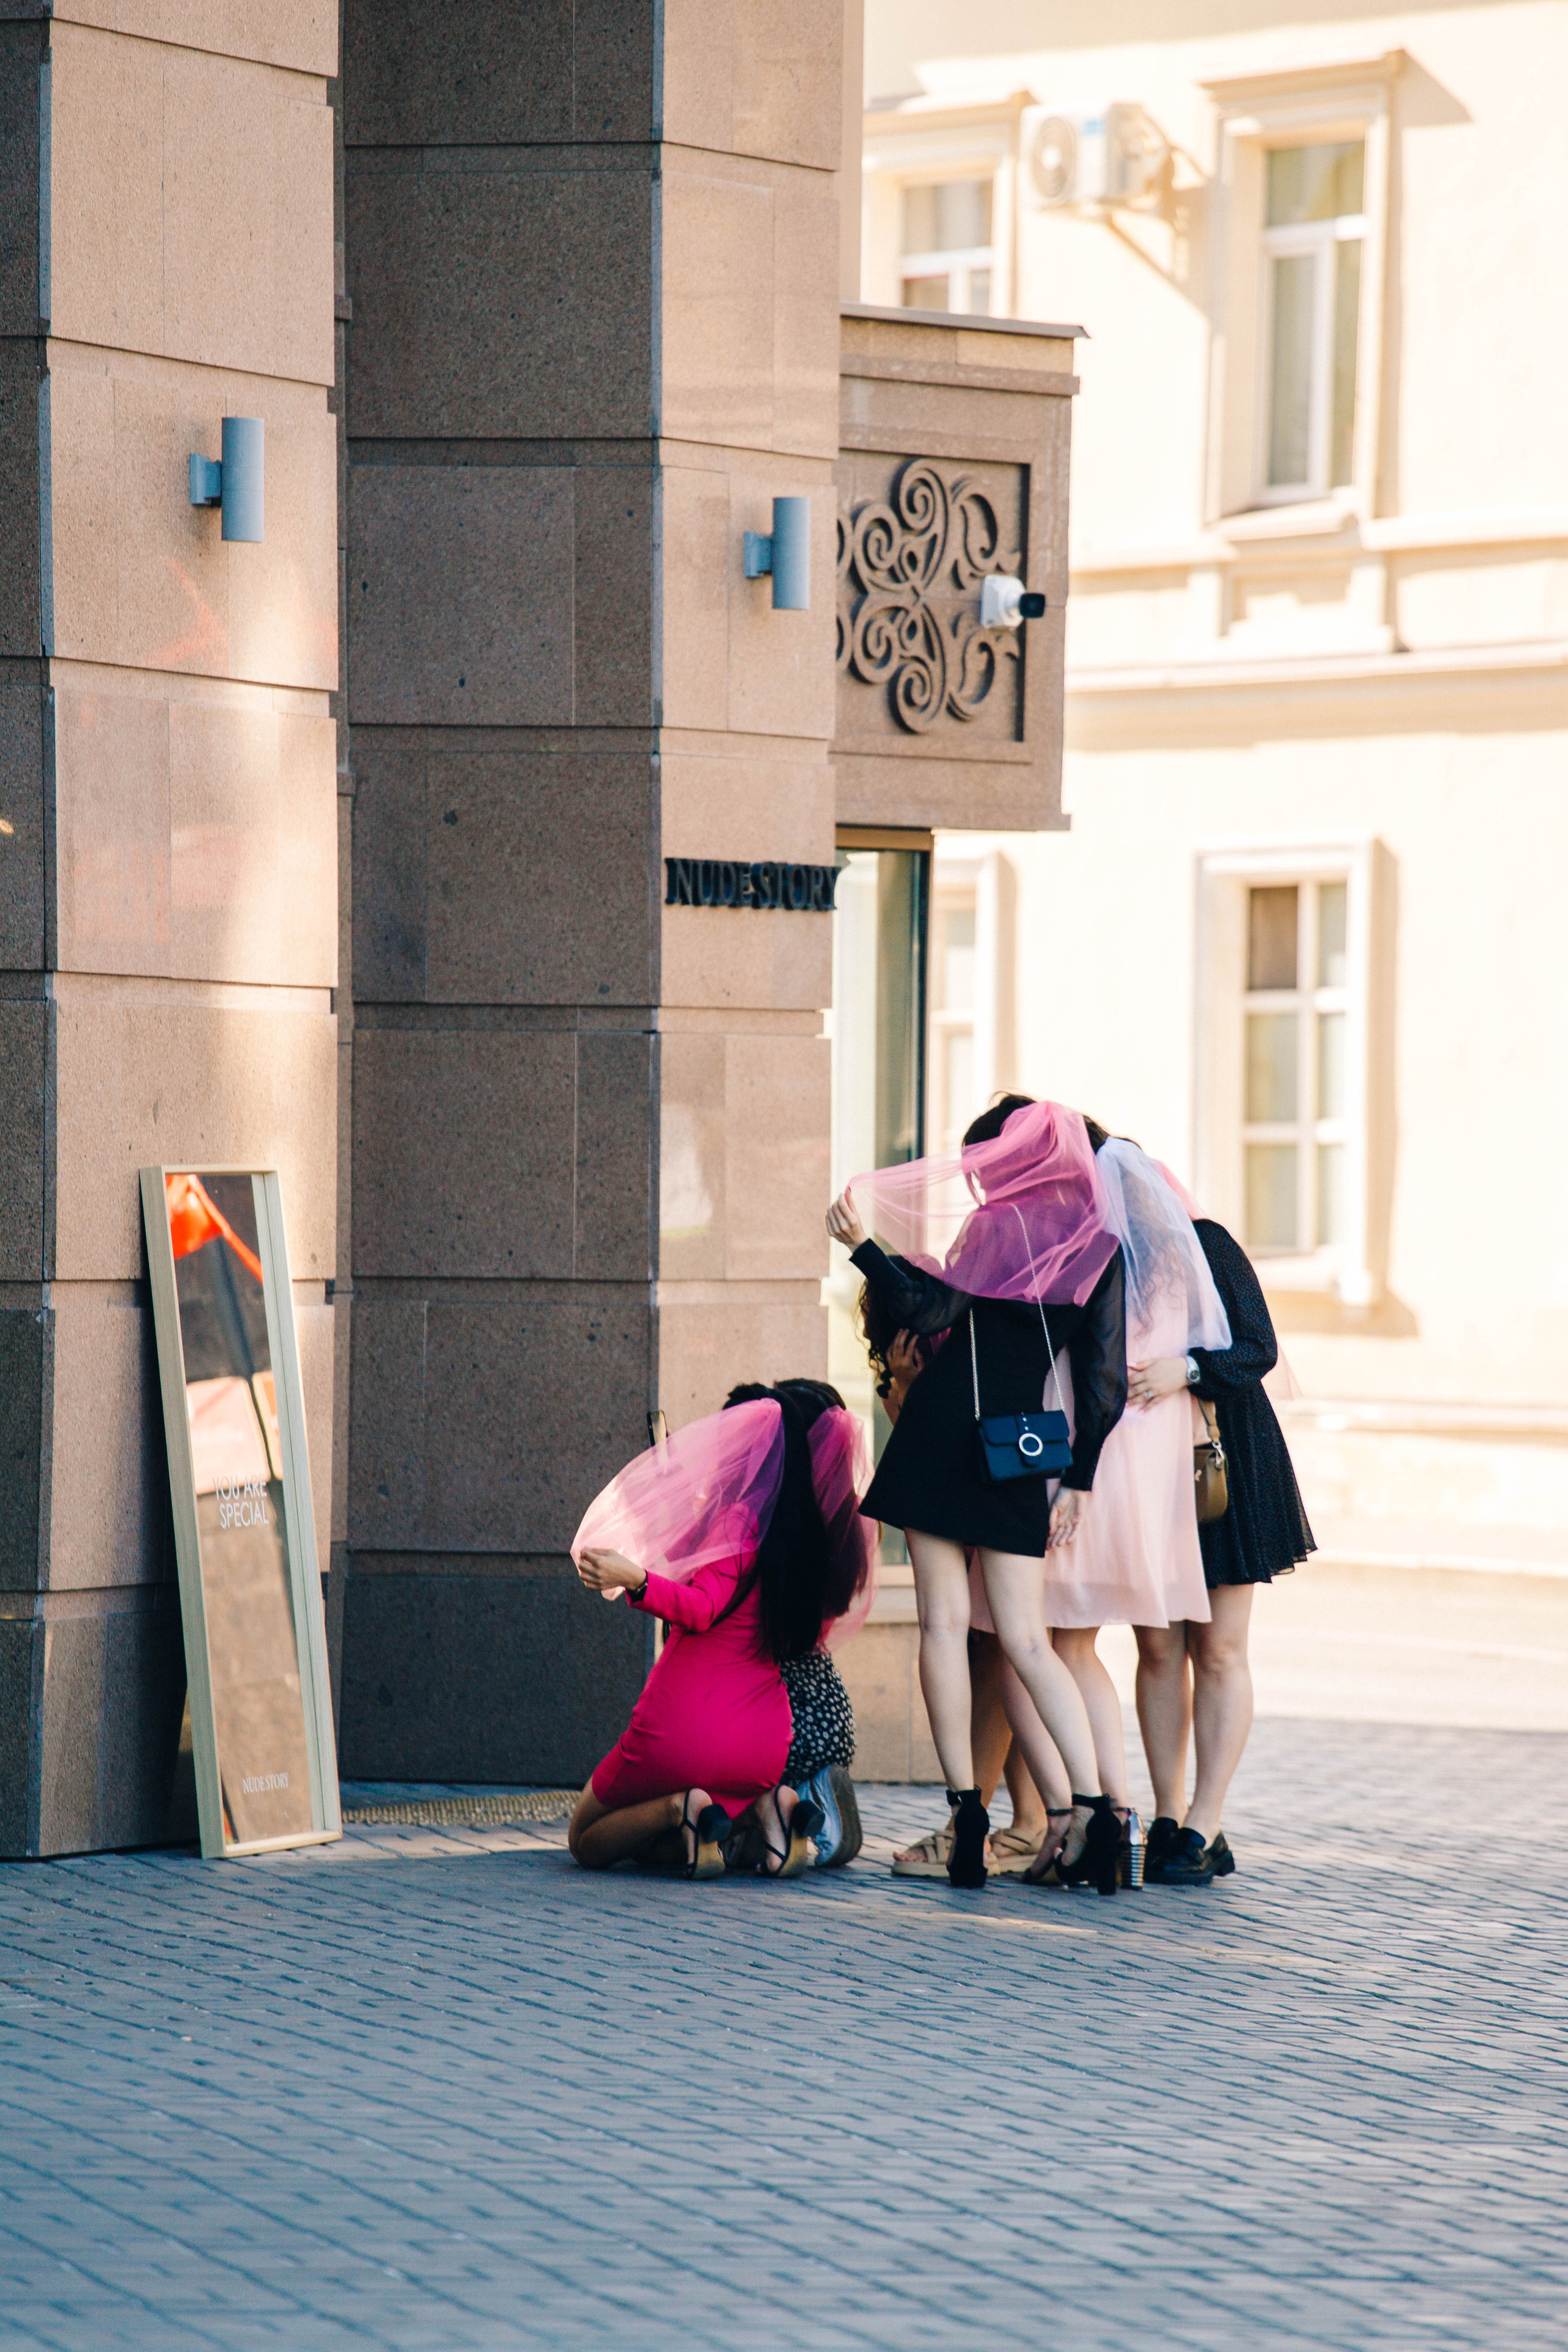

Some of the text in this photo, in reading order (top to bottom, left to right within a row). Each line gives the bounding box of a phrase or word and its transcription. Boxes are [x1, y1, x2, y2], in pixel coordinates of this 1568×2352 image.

[211, 1474, 267, 1501] YOU ARE
[219, 1500, 269, 1529] SPECIAL
